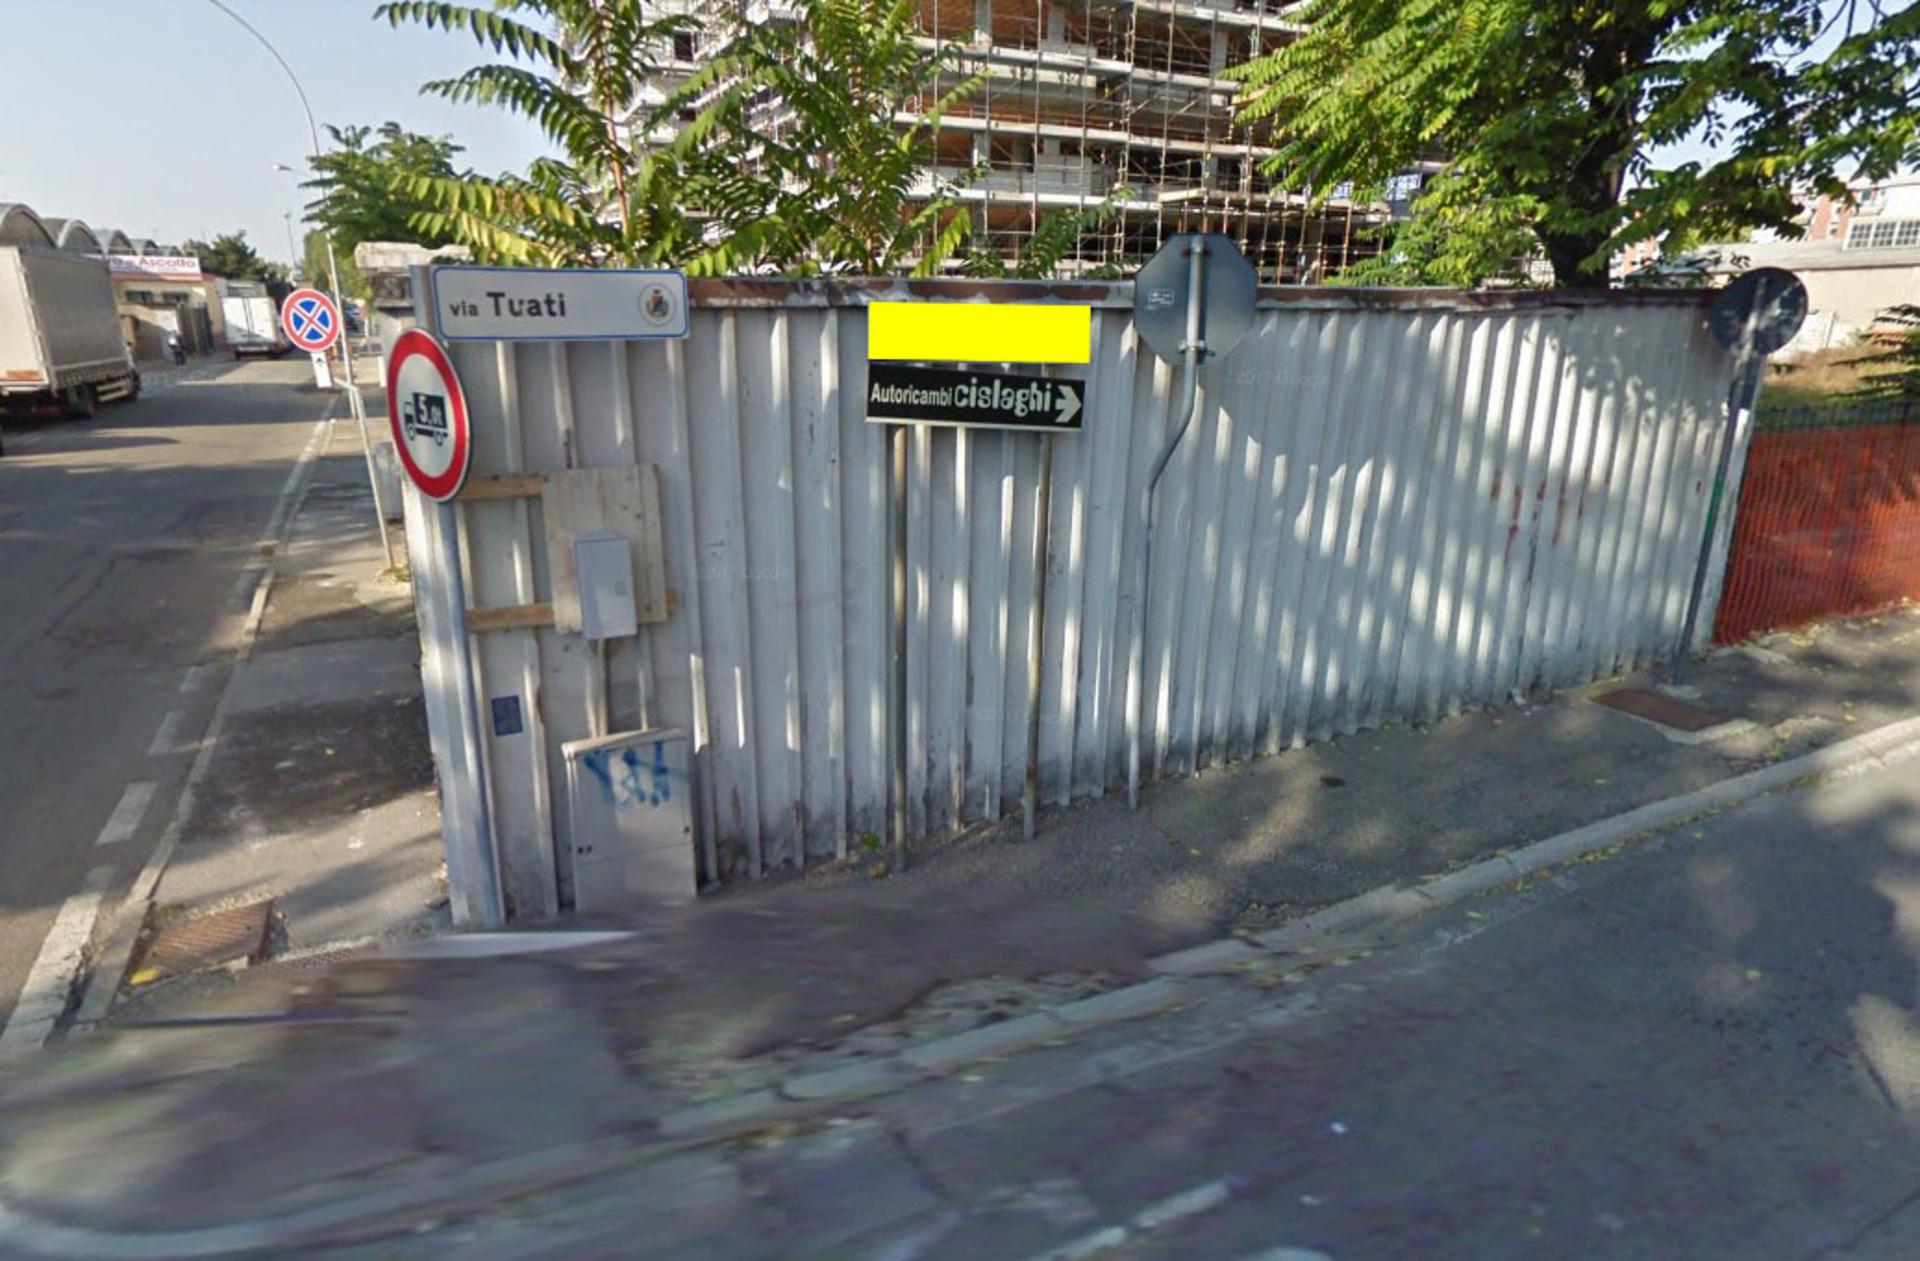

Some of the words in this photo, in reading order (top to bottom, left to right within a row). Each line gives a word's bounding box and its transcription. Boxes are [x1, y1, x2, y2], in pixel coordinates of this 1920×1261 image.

[139, 257, 196, 269] Ascolto
[449, 300, 479, 317] via
[871, 382, 953, 407] Autoricambi
